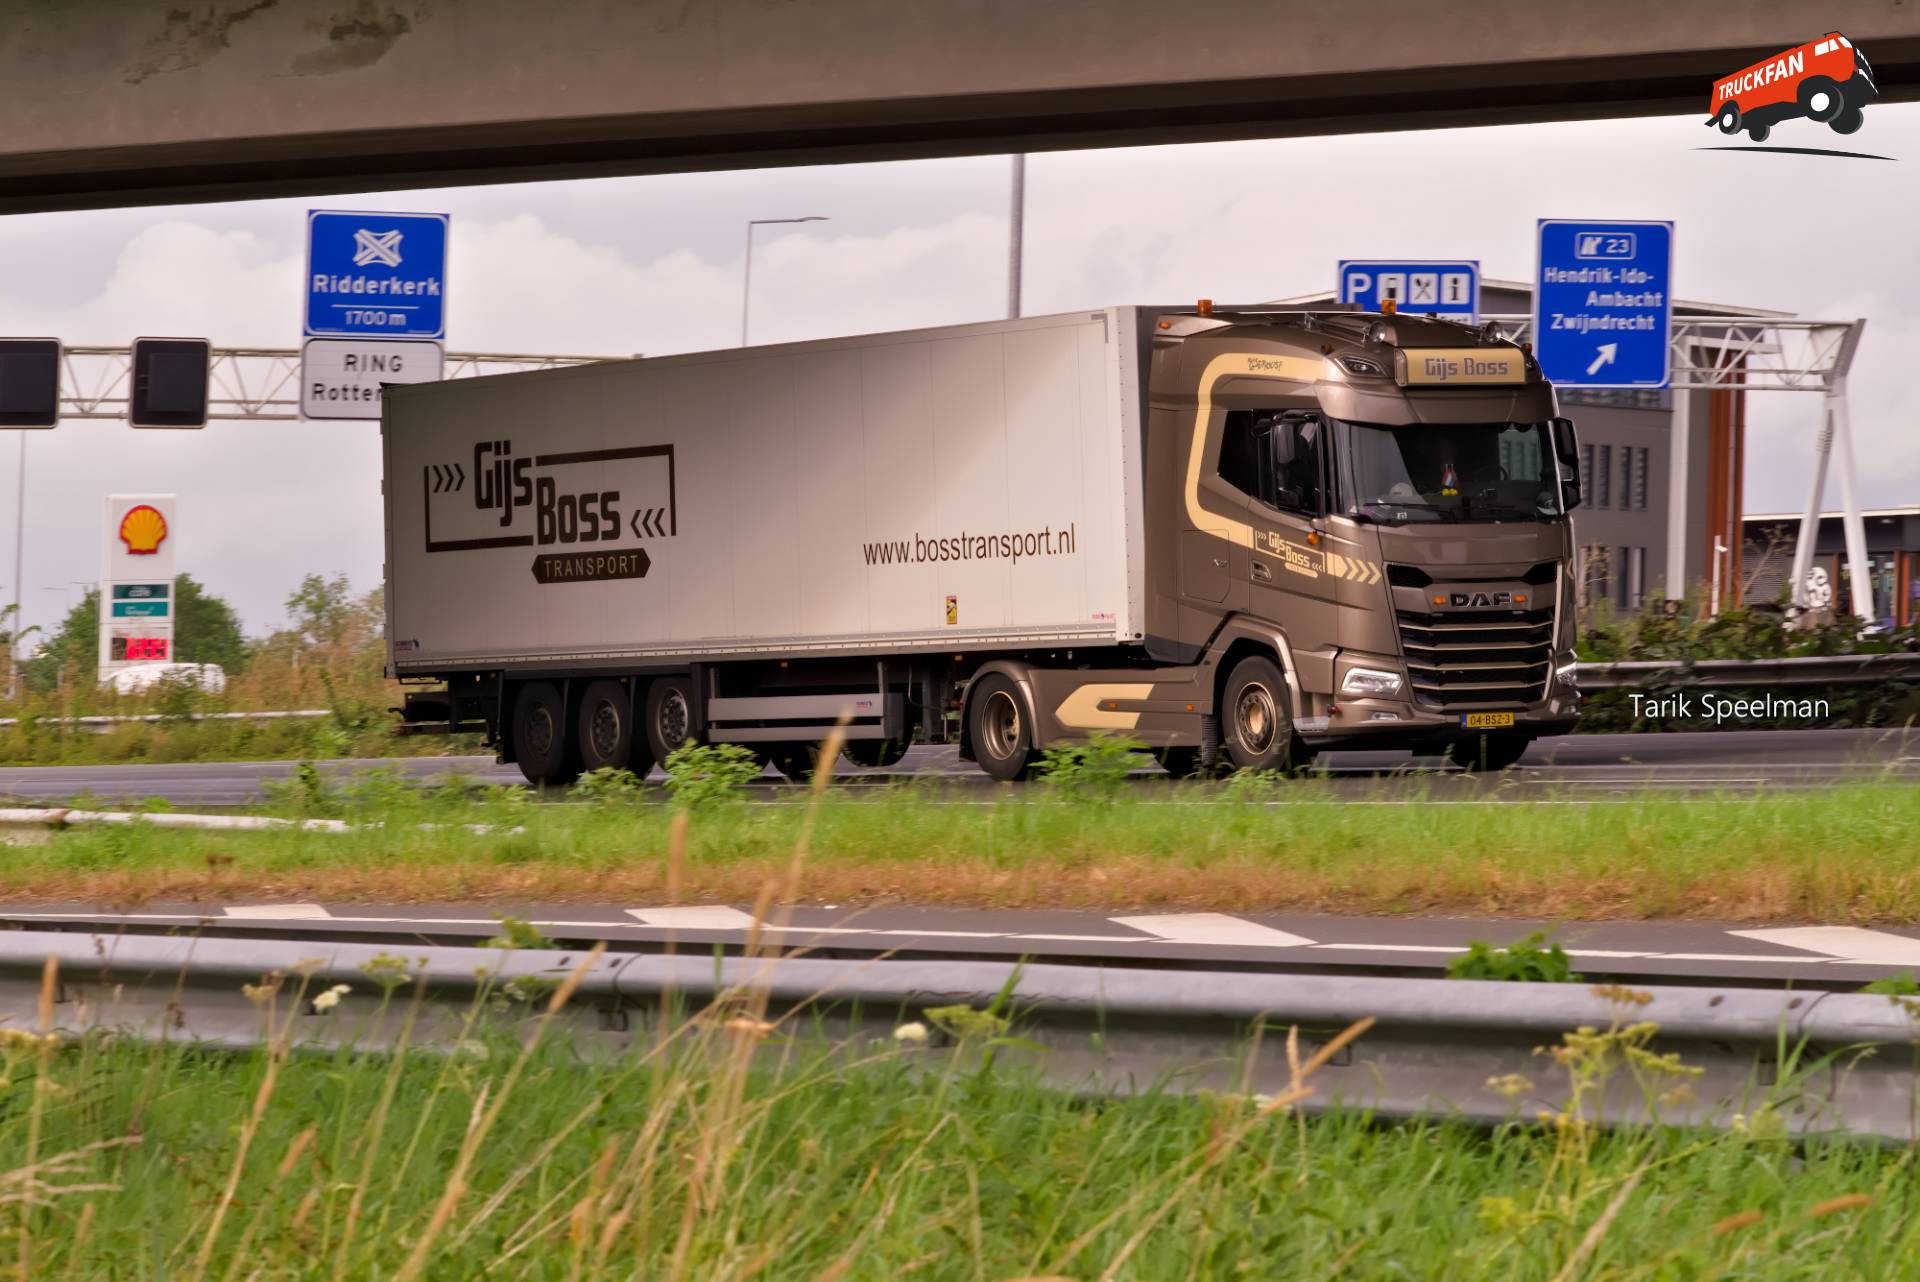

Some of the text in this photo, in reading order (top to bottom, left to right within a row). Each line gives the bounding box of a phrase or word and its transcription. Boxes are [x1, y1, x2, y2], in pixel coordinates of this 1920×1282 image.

[1605, 238, 1630, 254] 23
[312, 274, 441, 296] Ridderkerk
[1543, 267, 1655, 284] Hendrik-Ido-
[1585, 290, 1663, 308] Ambacht
[1550, 313, 1656, 335] Zwijndrecht
[344, 353, 404, 373] RING
[1424, 357, 1509, 381] Gijs Boss
[311, 382, 383, 402] Rotter
[474, 439, 533, 527] Gijs
[863, 522, 1076, 566] www.bosstransport.nl
[1268, 531, 1285, 553] Gijs
[543, 554, 639, 578] TRANSPORT
[1450, 591, 1512, 608] DAF
[1469, 713, 1511, 727] 04-BSZ-3
